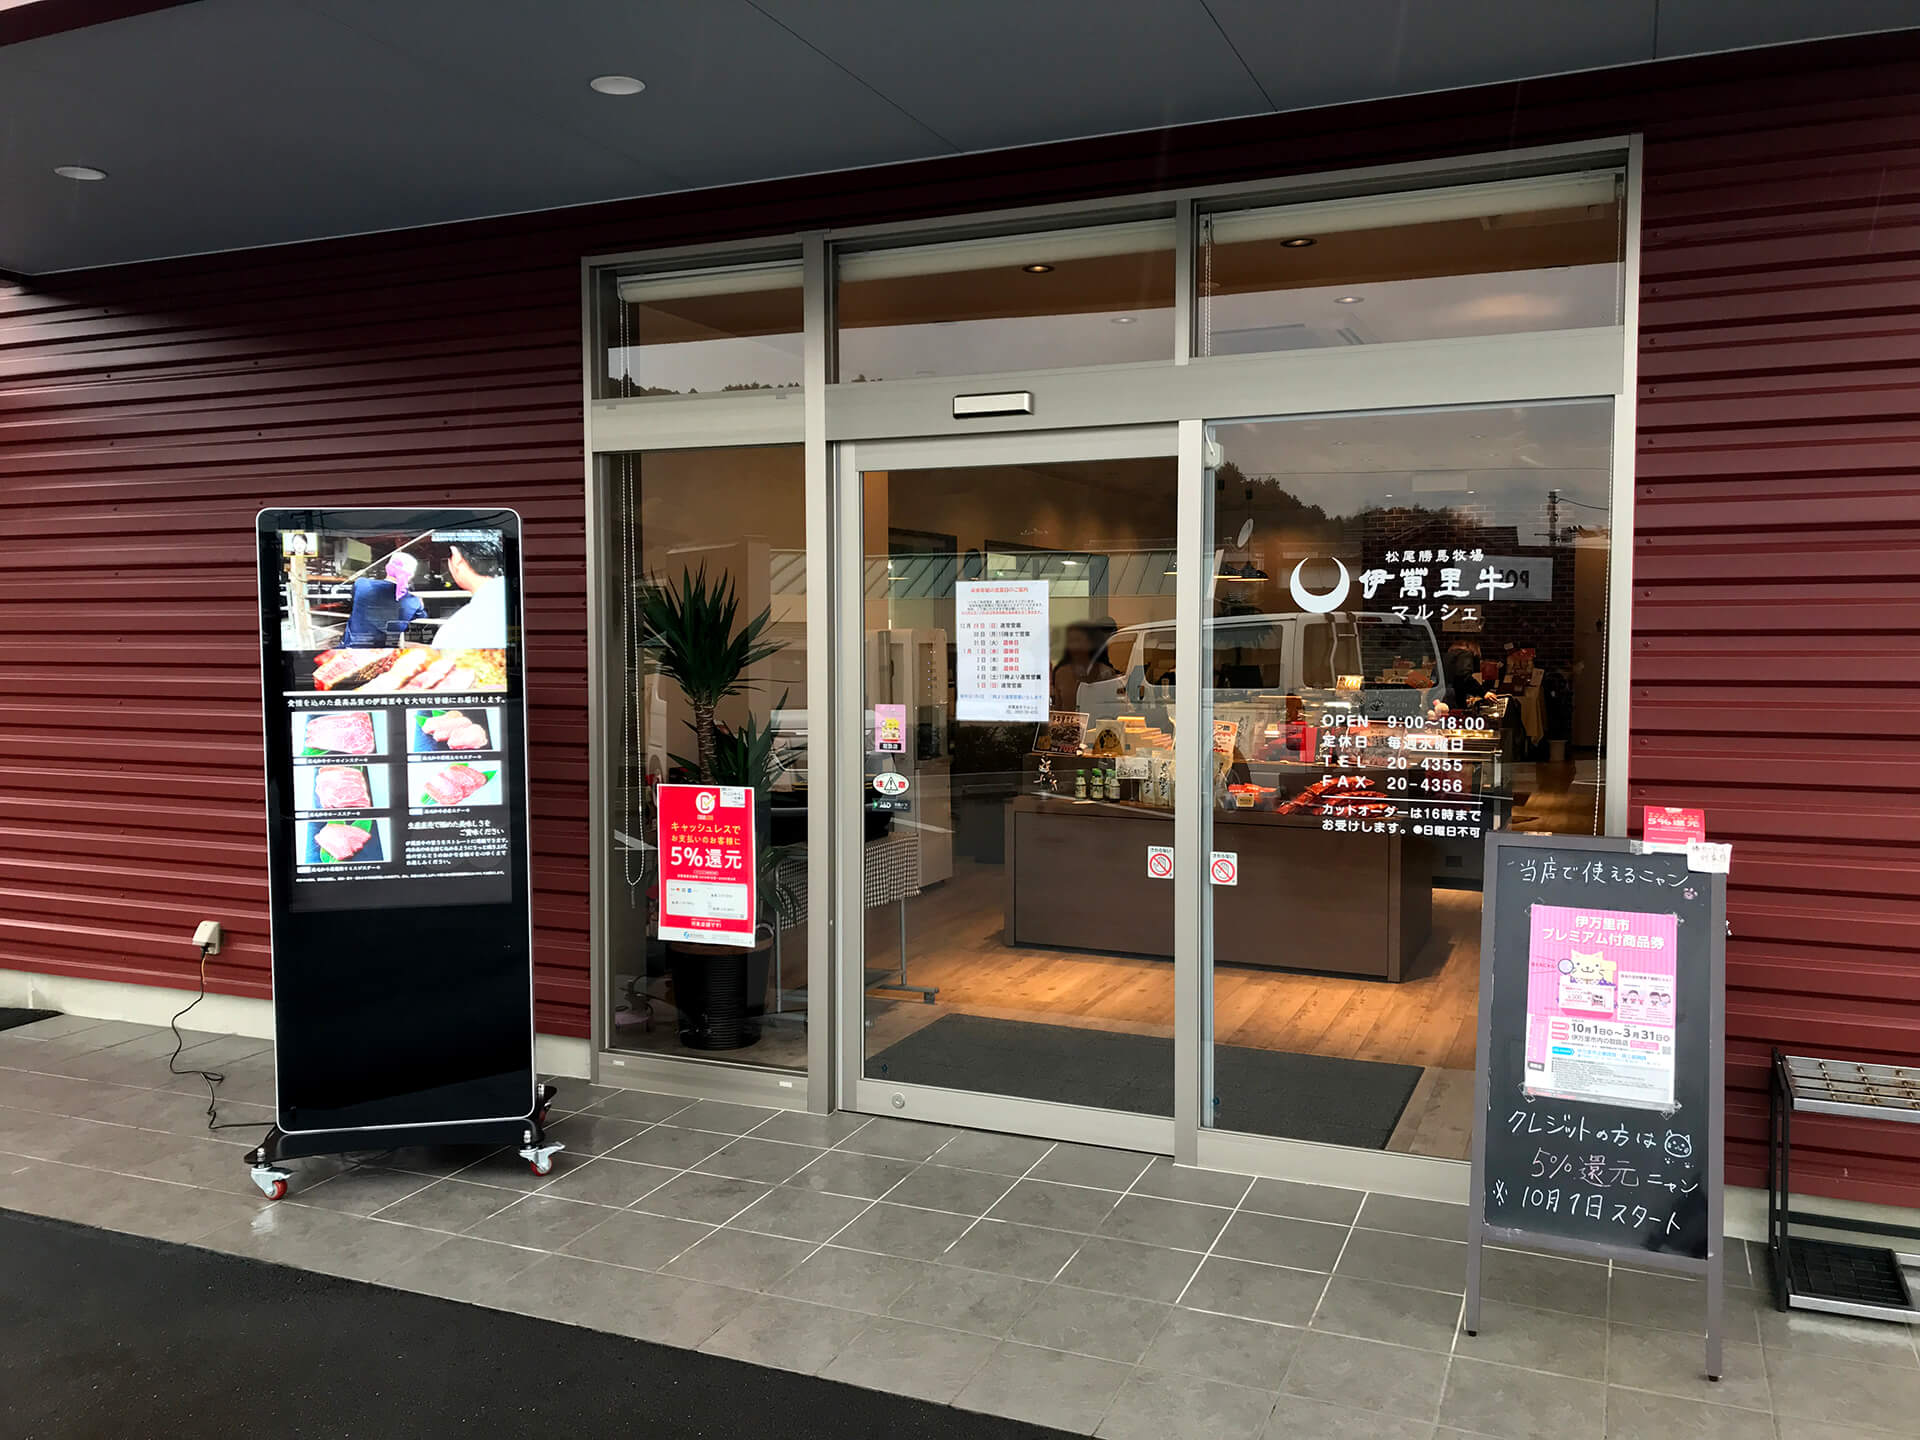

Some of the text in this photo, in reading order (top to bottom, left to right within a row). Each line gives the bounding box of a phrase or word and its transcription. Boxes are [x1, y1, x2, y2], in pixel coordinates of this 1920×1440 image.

[1385, 548, 1484, 563] 松尾勝馬牧場
[1358, 565, 1514, 602] 伊萬里牛
[1391, 603, 1479, 621] マルシェ
[1321, 714, 1369, 729] OPEN
[1321, 735, 1464, 751] 定休日 毎週水曜日
[1322, 755, 1463, 773] TEL 20-4355
[1321, 775, 1463, 793] FAX 20-4356
[1321, 803, 1481, 823] カットオーダーは16時まで
[671, 821, 741, 834] キャッシュレスで
[671, 835, 741, 846] お支払いのお客様に
[670, 846, 742, 869] 5%還元
[1575, 915, 1630, 932] 伊万里市
[1542, 928, 1665, 950] プレミアム付商品券
[1508, 1110, 1657, 1148] クレジットの方は
[1531, 1147, 1640, 1188] 5%還元
[1611, 1203, 1681, 1235] スタート
